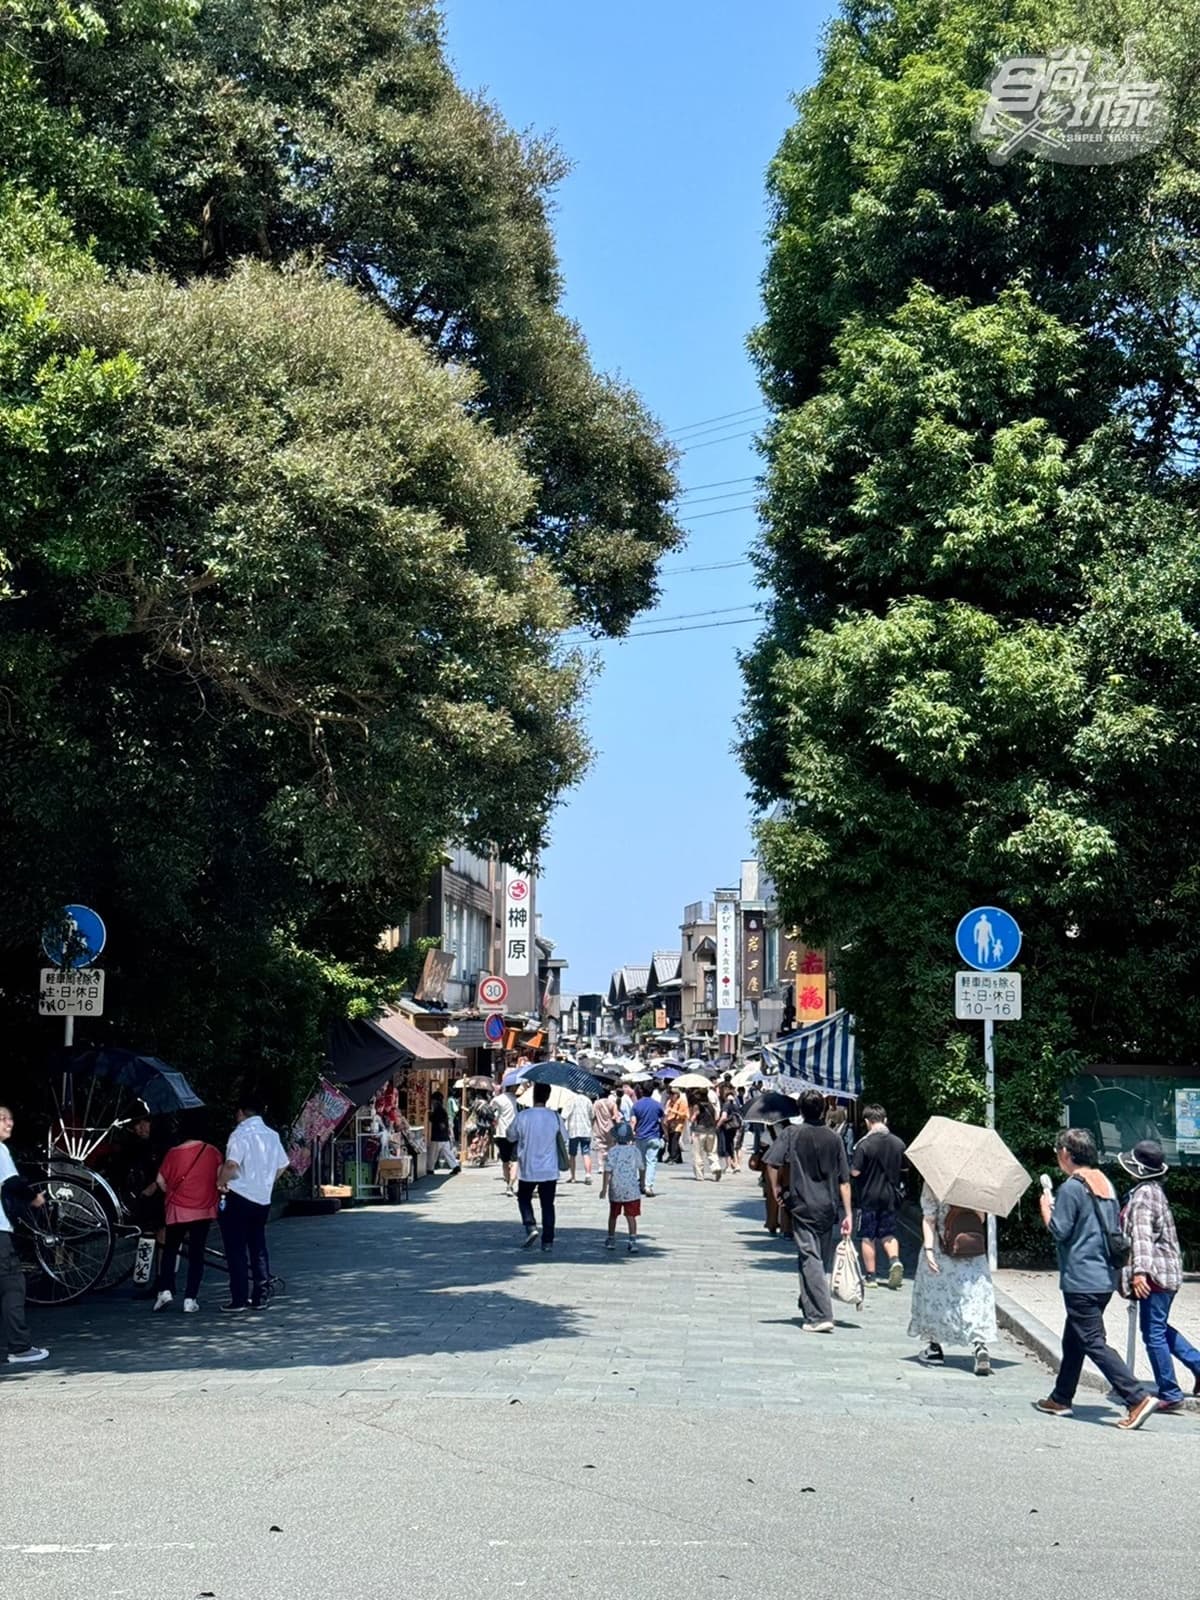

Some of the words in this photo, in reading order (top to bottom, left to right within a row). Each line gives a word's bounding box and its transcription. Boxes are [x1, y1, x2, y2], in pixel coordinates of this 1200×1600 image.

[507, 907, 527, 960] 榊原
[961, 976, 1016, 989] 軽車両を除く
[486, 984, 501, 997] 30
[966, 1003, 1011, 1015] 10-16
